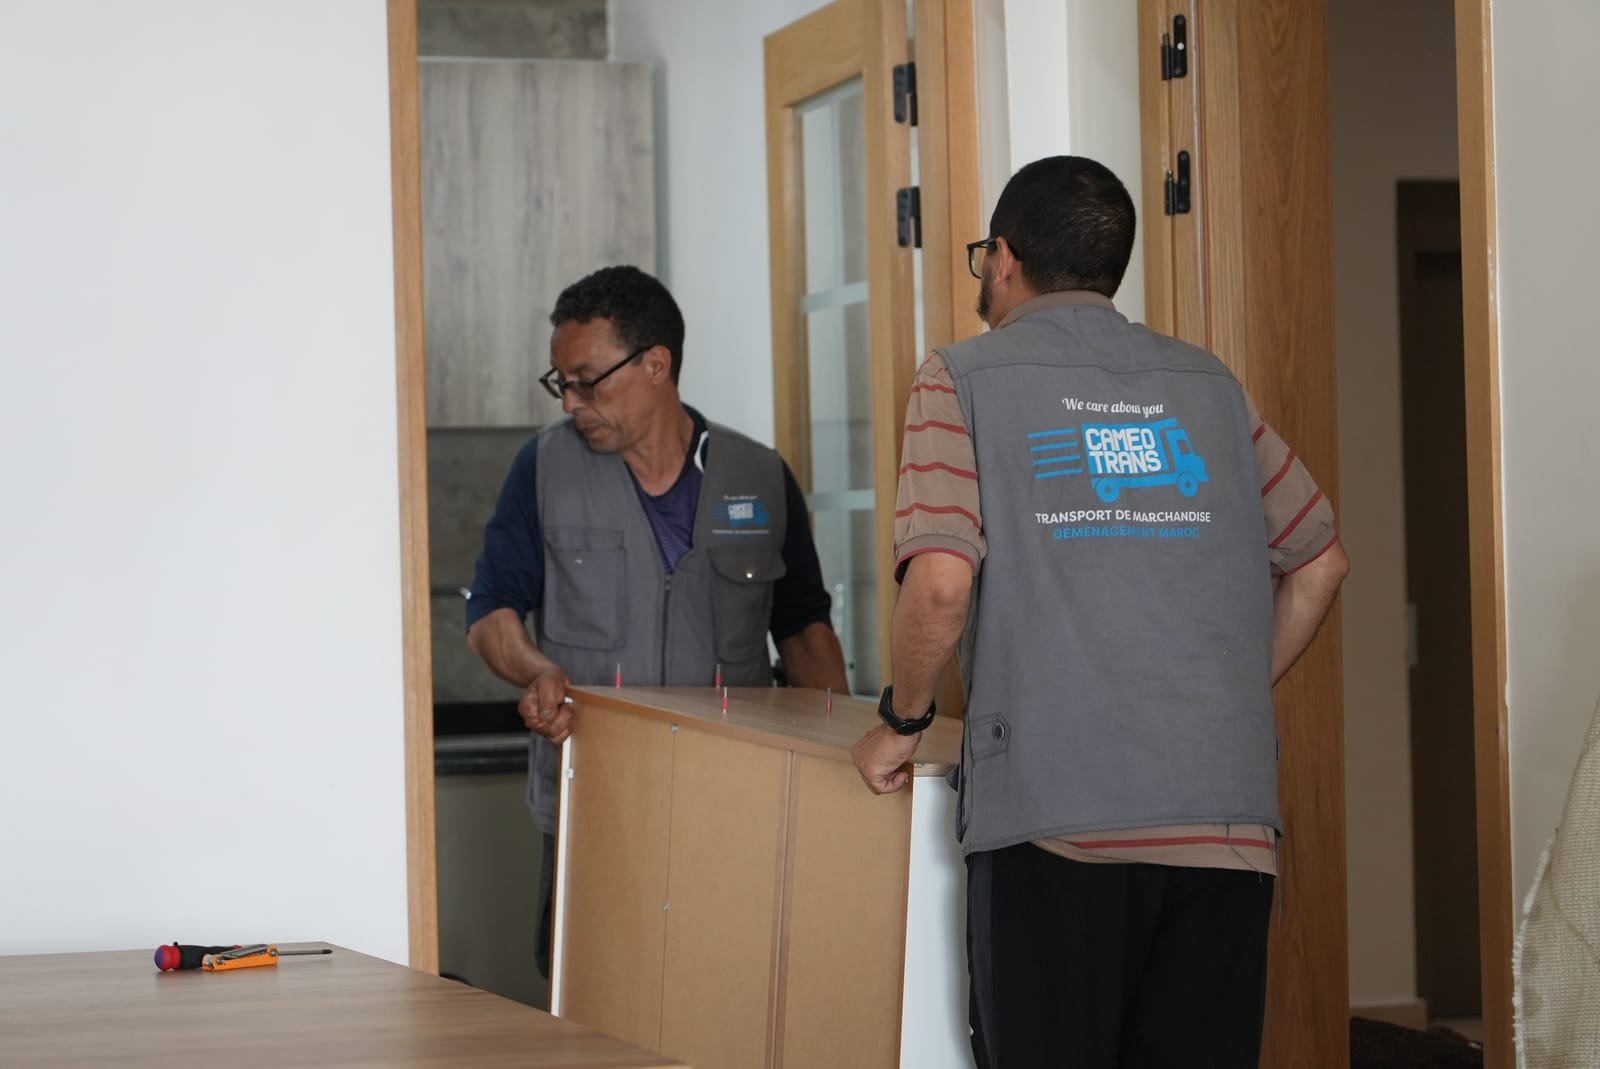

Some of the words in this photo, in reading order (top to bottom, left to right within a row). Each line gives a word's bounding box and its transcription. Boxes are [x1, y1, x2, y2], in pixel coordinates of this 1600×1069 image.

[1062, 398, 1084, 411] We
[1086, 401, 1109, 413] care
[1142, 403, 1165, 419] you
[1085, 428, 1156, 451] CAMEO
[1088, 450, 1162, 474] TRANS
[1035, 509, 1112, 524] TRANSPORT
[1115, 509, 1131, 521] DE
[1132, 511, 1211, 523] MARCHANDISE
[1158, 527, 1200, 539] MAROC
